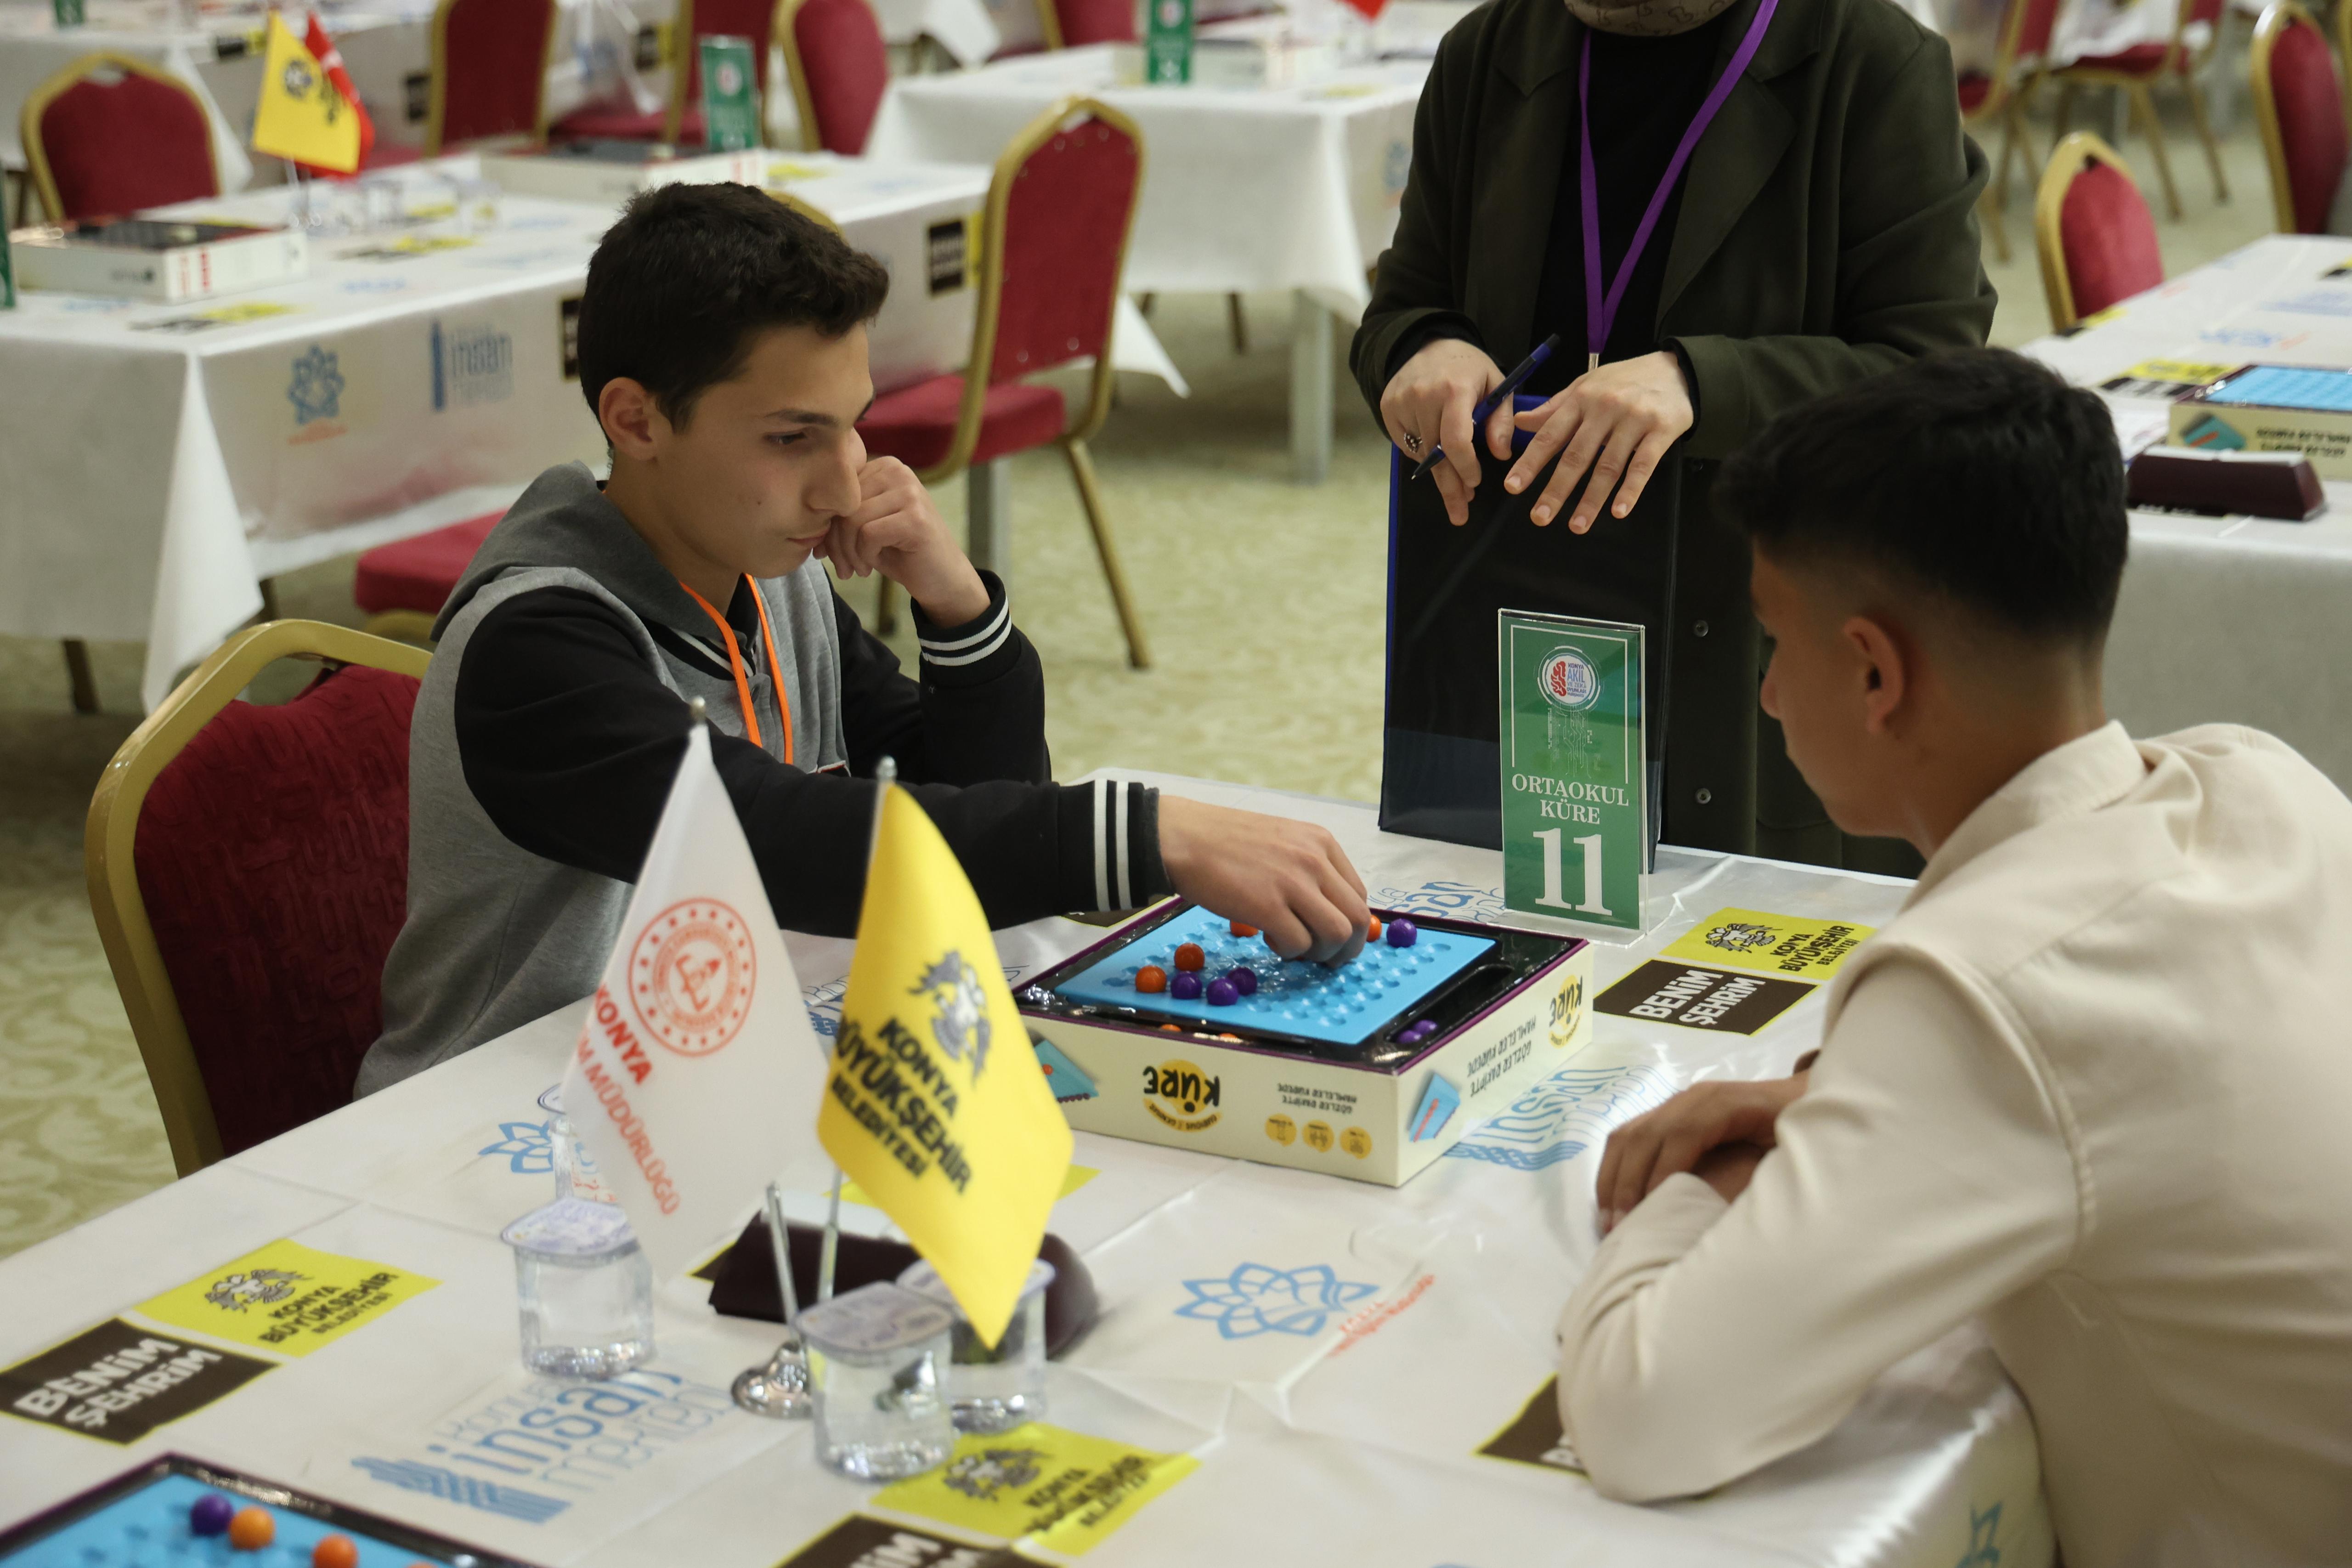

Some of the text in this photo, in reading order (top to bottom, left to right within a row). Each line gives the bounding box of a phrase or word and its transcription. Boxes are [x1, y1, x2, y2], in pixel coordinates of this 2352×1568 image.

[1567, 668, 1585, 683] AKIL
[1512, 773, 1629, 806] ORTAOKUL
[1540, 798, 1600, 825] KÜRE
[1532, 827, 1612, 916] 11
[878, 1016, 958, 1120] KONYA
[1503, 1040, 1532, 1073] GÖZLER
[836, 1014, 972, 1194] ÜYÜKŞEHİR
[1142, 1066, 1220, 1113] KÜRE
[258, 1272, 399, 1343] BÜYÜKŞEHİR
[268, 1286, 342, 1319] KONYA
